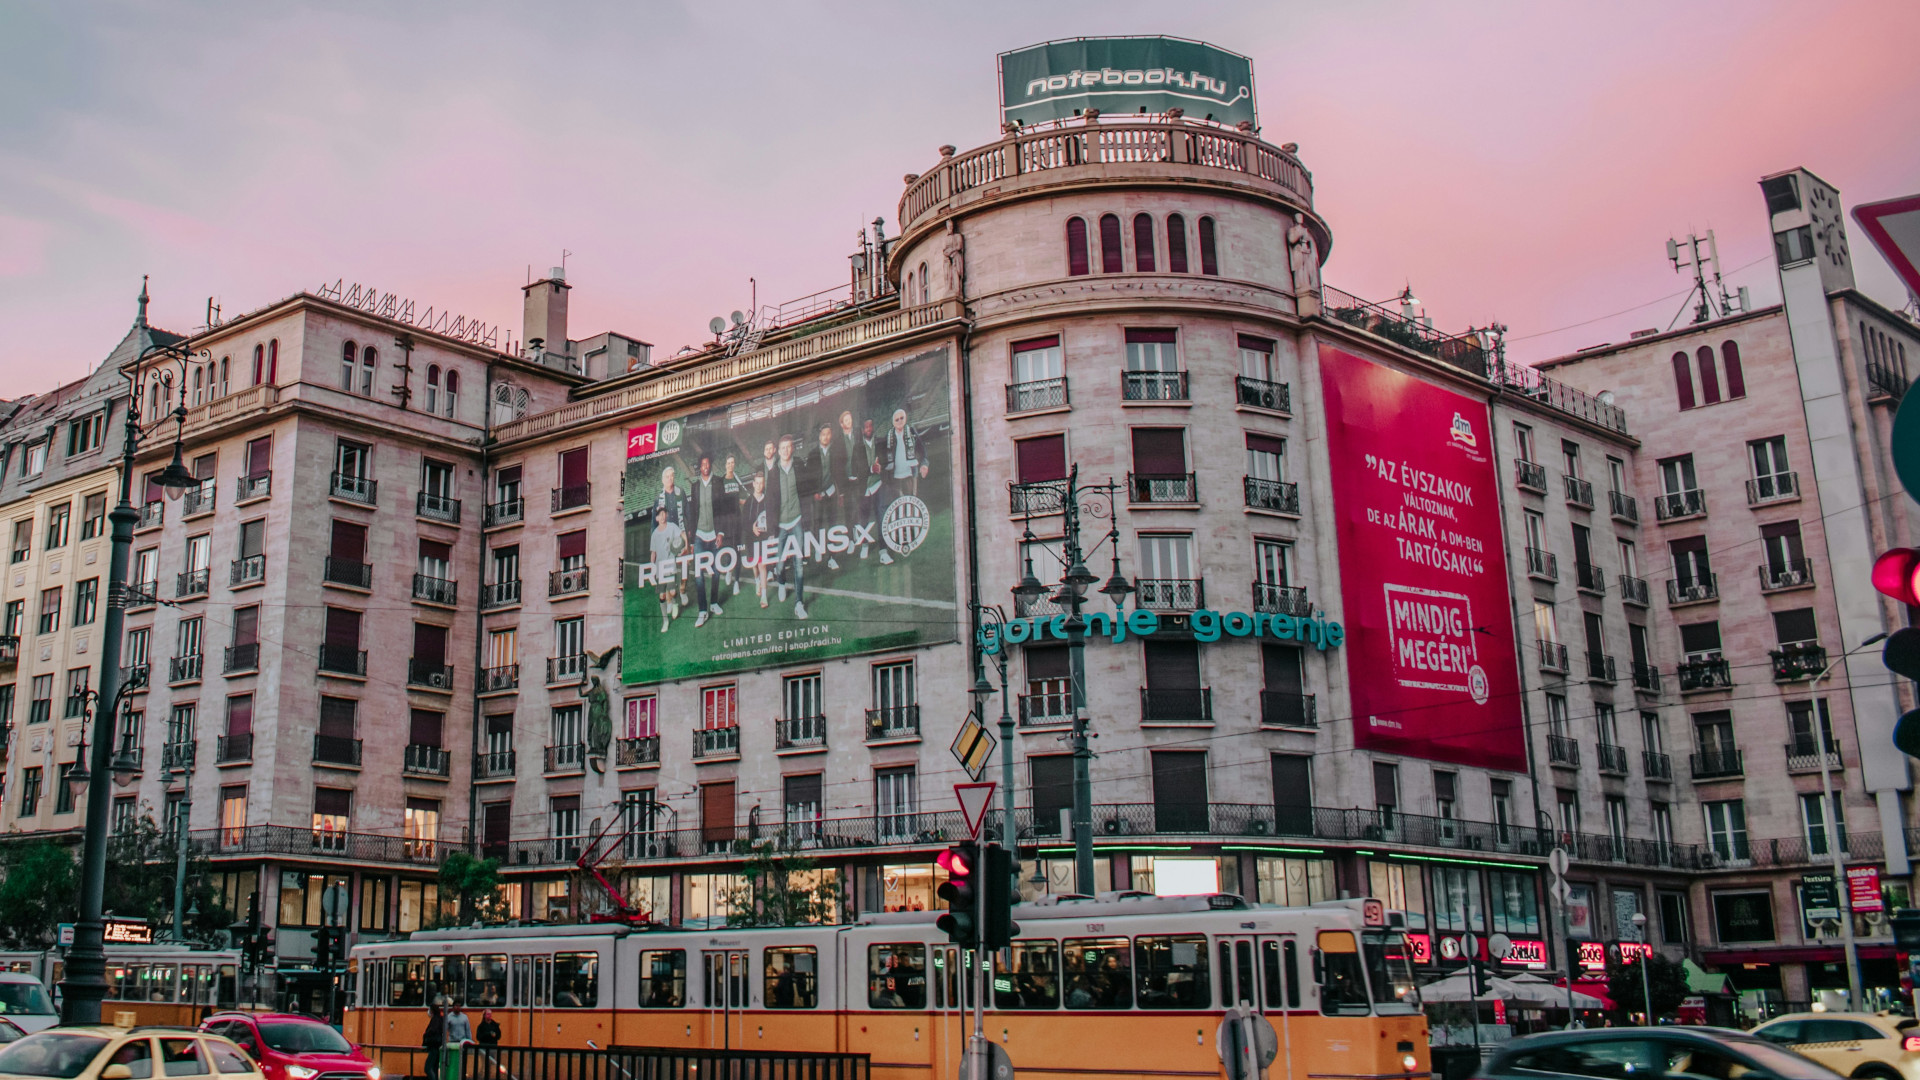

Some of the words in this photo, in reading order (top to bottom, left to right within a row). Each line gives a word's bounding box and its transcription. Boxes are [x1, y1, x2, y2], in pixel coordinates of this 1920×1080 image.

[1026, 67, 1226, 96] notebook.hu
[628, 455, 645, 464] official
[646, 447, 680, 460] collaboration
[1402, 461, 1473, 507] ÉVSZAKOK
[1403, 492, 1458, 523] VÁLTOZNAK,
[1367, 508, 1381, 524] DE
[1384, 513, 1396, 529] AZ
[1399, 505, 1437, 540] ÁRAK
[1441, 529, 1447, 543] A
[1449, 531, 1483, 553] DM-BEN
[741, 525, 850, 569] JEANS
[977, 603, 1158, 655] gorenje
[1190, 609, 1344, 651] gorenje
[1394, 599, 1463, 637] MINDIG
[712, 645, 783, 662] retrojeans.com/ftc
[789, 636, 842, 652] shop.fradi.hu
[723, 633, 772, 648] LIMITED
[778, 625, 829, 640] EDITION
[1803, 874, 1831, 883] Textúra
[1847, 868, 1877, 877] DIEGO
